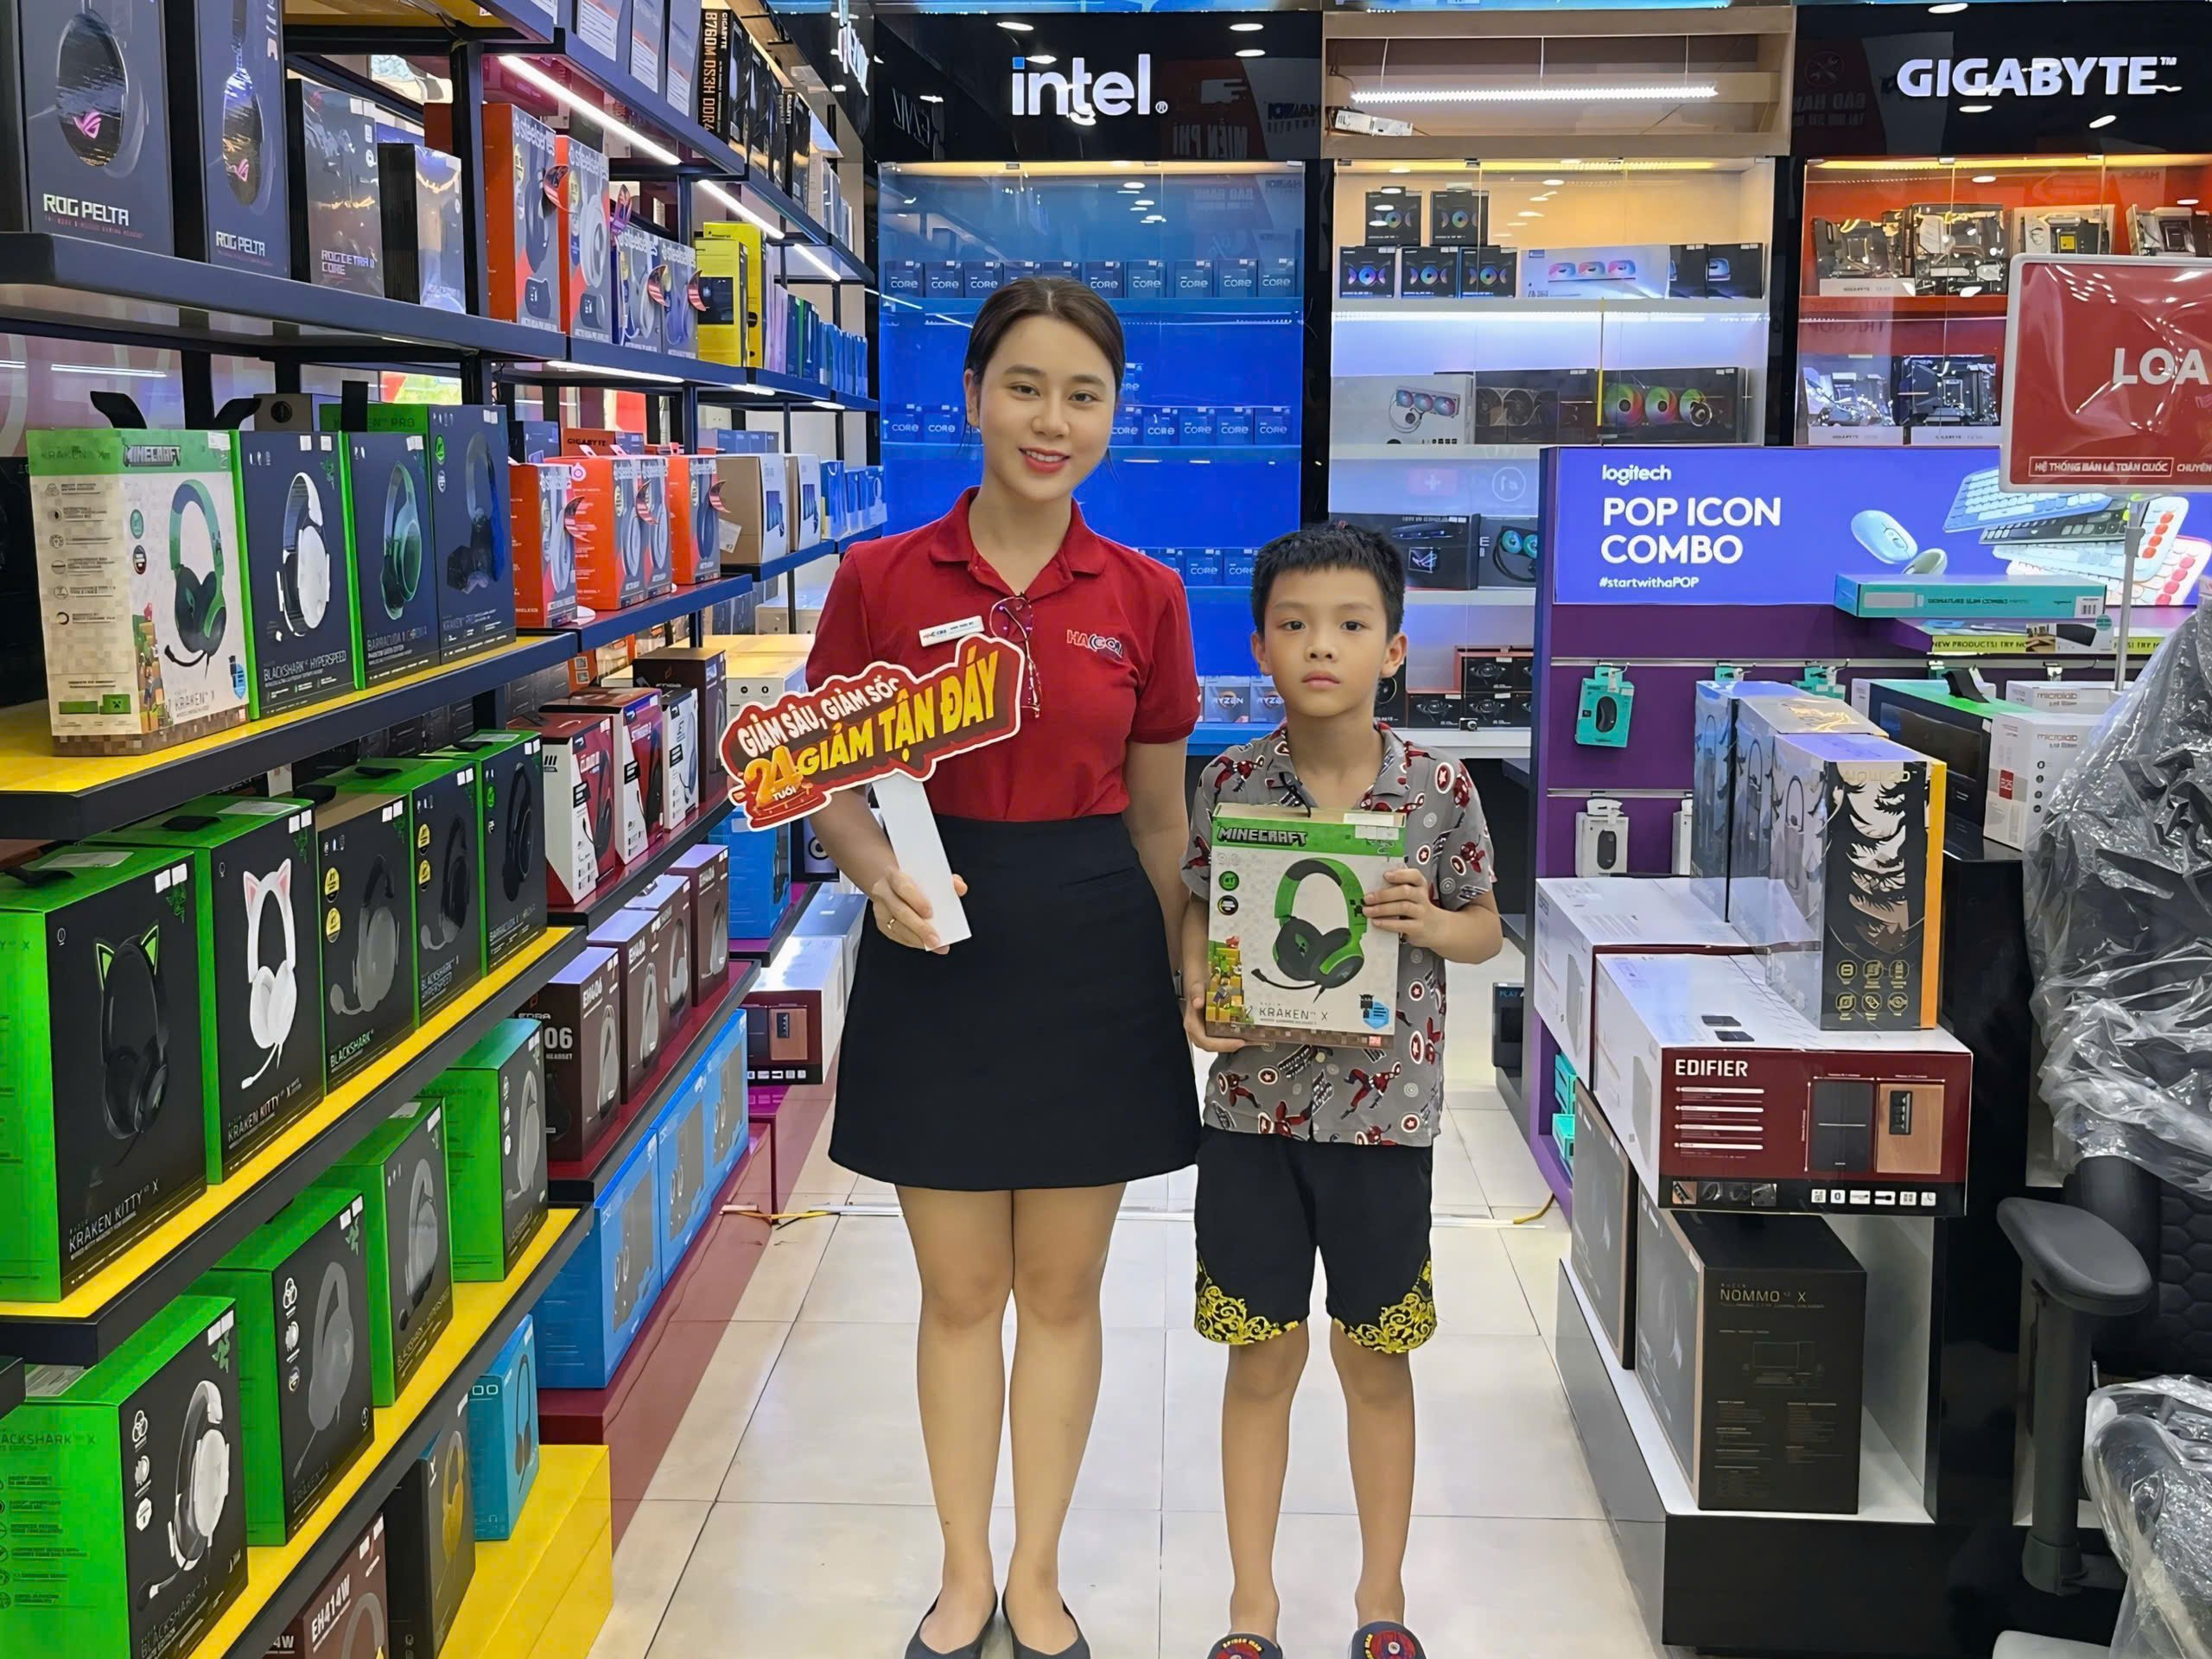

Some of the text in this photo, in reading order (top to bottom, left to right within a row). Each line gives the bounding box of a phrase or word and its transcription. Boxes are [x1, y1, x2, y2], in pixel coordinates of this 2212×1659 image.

[704, 12, 717, 56] B760M
[703, 60, 716, 93] DS3H
[1012, 54, 1151, 115] intel
[1897, 58, 2158, 97] GIGABYTE
[43, 194, 129, 226] ROG PELTA
[216, 231, 265, 257] ROG PELTA
[321, 262, 346, 275] CORE
[2113, 347, 2210, 385] LOA
[1602, 464, 1672, 486] logitech
[1604, 497, 1781, 526] POP ICON
[1600, 534, 1744, 564] COMBO
[1599, 575, 1700, 588] #startwithaPOP
[796, 645, 999, 775] GIẢM TẬN ĐÁY
[738, 713, 789, 758] GIẢM
[744, 745, 804, 809] 24
[1217, 826, 1308, 847] MINECRAFT
[1259, 1007, 1309, 1020] KRAKEN
[1321, 1012, 1328, 1021] X
[1675, 1058, 1749, 1077] EDIFIER
[227, 1109, 258, 1142] KRAKEN
[259, 1091, 281, 1118] KITTY
[69, 1211, 111, 1253] KRAKEN
[115, 1189, 143, 1221] KITTY
[152, 1178, 158, 1194] X
[1720, 1289, 1780, 1302] NOMMO
[1797, 1291, 1806, 1303] X
[311, 1573, 350, 1643] EH414W
